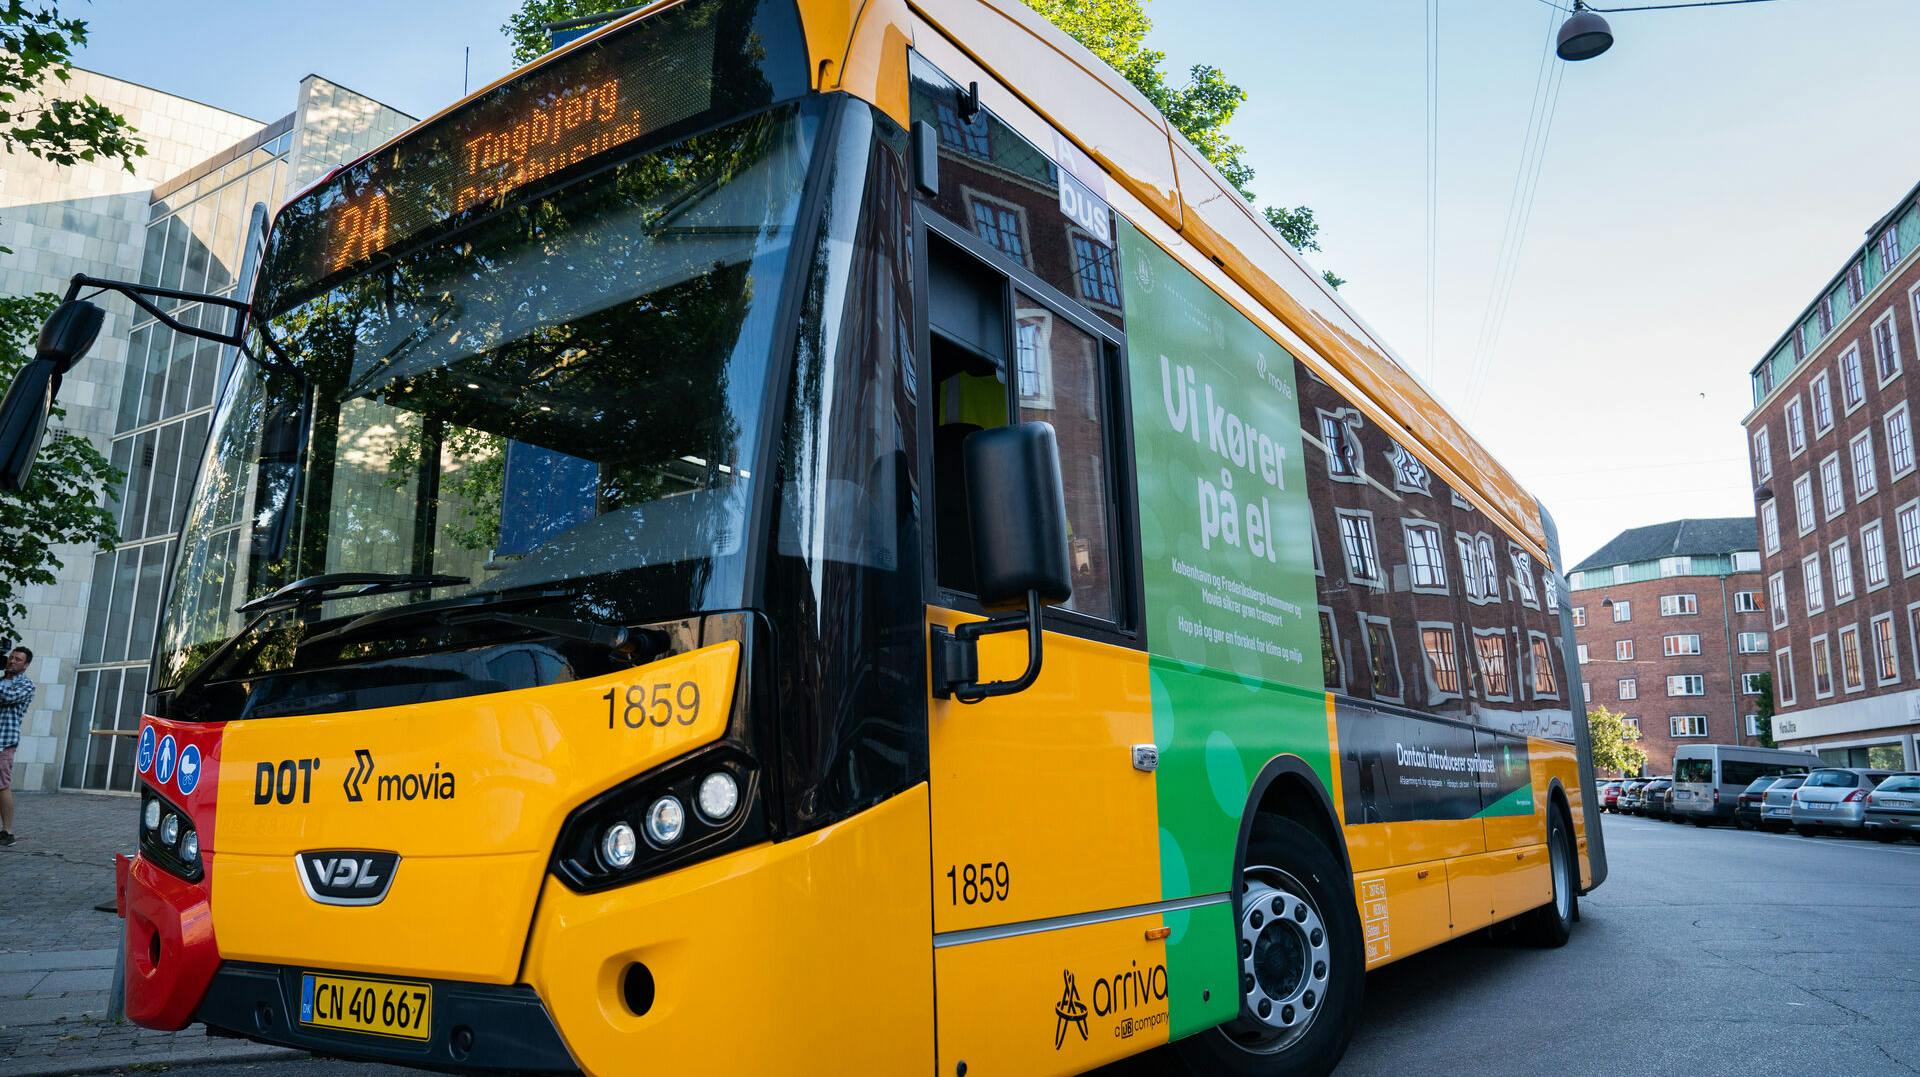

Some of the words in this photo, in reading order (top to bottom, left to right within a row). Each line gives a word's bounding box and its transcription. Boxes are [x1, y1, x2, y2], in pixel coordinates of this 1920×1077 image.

[466, 79, 619, 177] Tingbjerg
[1058, 168, 1109, 241] bus
[1267, 372, 1292, 400] movia
[1160, 354, 1201, 443] Vi
[1205, 383, 1286, 491] kører
[1197, 467, 1241, 551] på
[1246, 496, 1277, 563] el
[1171, 557, 1212, 585] København
[1212, 574, 1221, 590] og
[1202, 588, 1222, 608] Movia
[1178, 616, 1193, 637] Hop
[1193, 619, 1204, 638] på
[1204, 626, 1213, 642] og
[602, 680, 701, 730] 1859
[1396, 742, 1427, 767] Dantaxi
[377, 762, 455, 801] movia
[312, 858, 380, 888] VDL
[946, 861, 1010, 906] 1859
[303, 1002, 312, 1014] DK
[315, 983, 344, 1020] CN
[349, 986, 376, 1025] 40
[382, 988, 427, 1030] 667
[1093, 959, 1169, 1018] arriva
[1134, 1011, 1169, 1031] company
